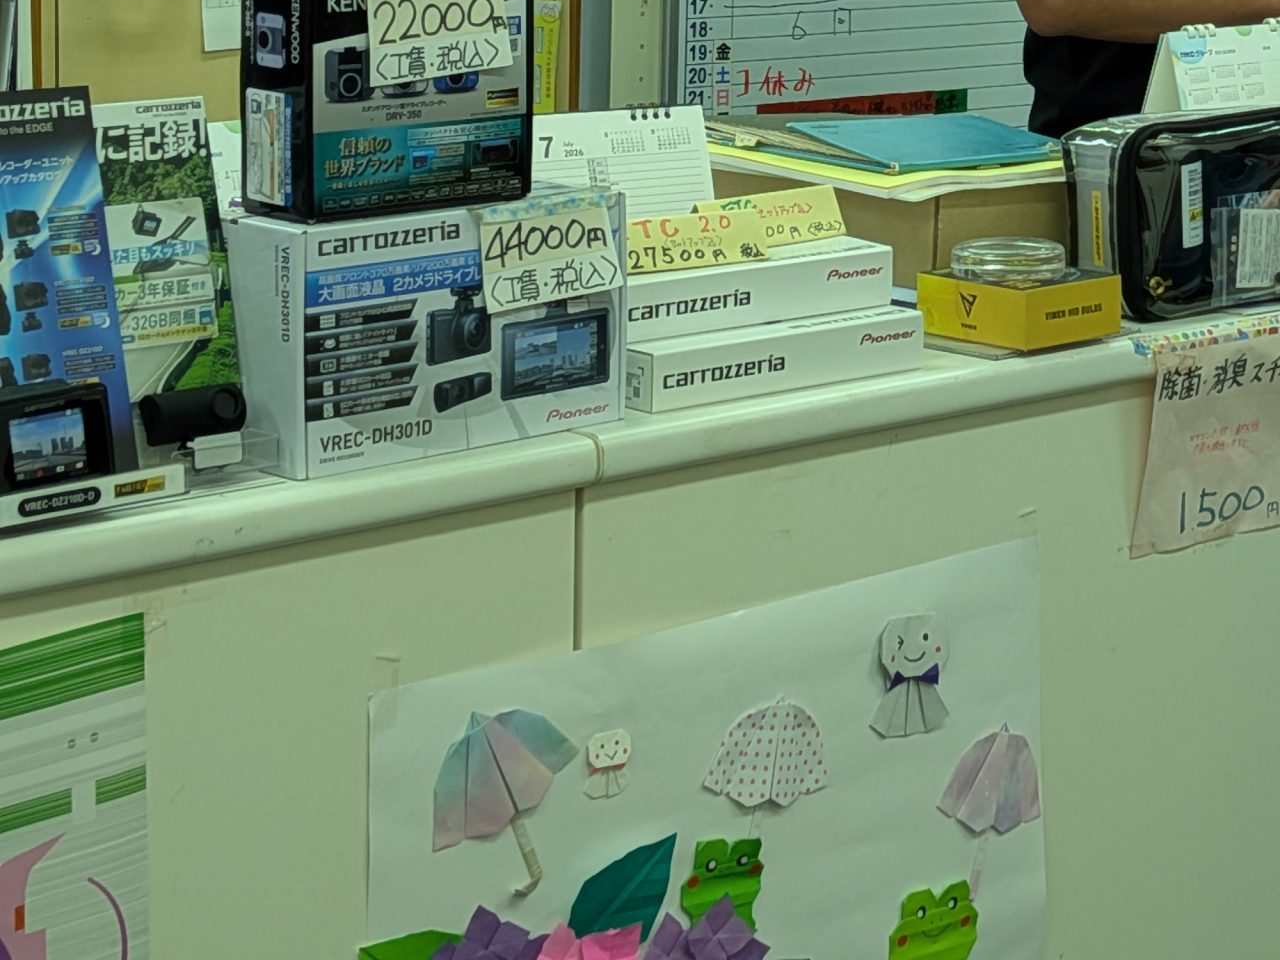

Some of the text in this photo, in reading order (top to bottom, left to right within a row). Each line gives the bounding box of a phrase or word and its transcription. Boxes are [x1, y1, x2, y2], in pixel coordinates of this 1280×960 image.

[759, 67, 815, 96] 休み
[135, 100, 201, 114] carrozzeria
[26, 122, 53, 133] EDGE
[340, 136, 391, 156] 信頼の
[539, 136, 553, 158] 7
[565, 149, 584, 157] 2026
[324, 156, 404, 178] 世界ブランド
[318, 221, 460, 257] carrozzeria
[632, 219, 680, 239] TC
[281, 247, 291, 343] VREC-DH301D
[318, 279, 385, 303] 大画面液晶
[628, 266, 884, 322] carrozzeria Pioneer
[663, 330, 916, 390] carrozzeria Pioneer
[545, 403, 610, 423] Pioneer
[320, 419, 433, 453] VREC-DH301D
